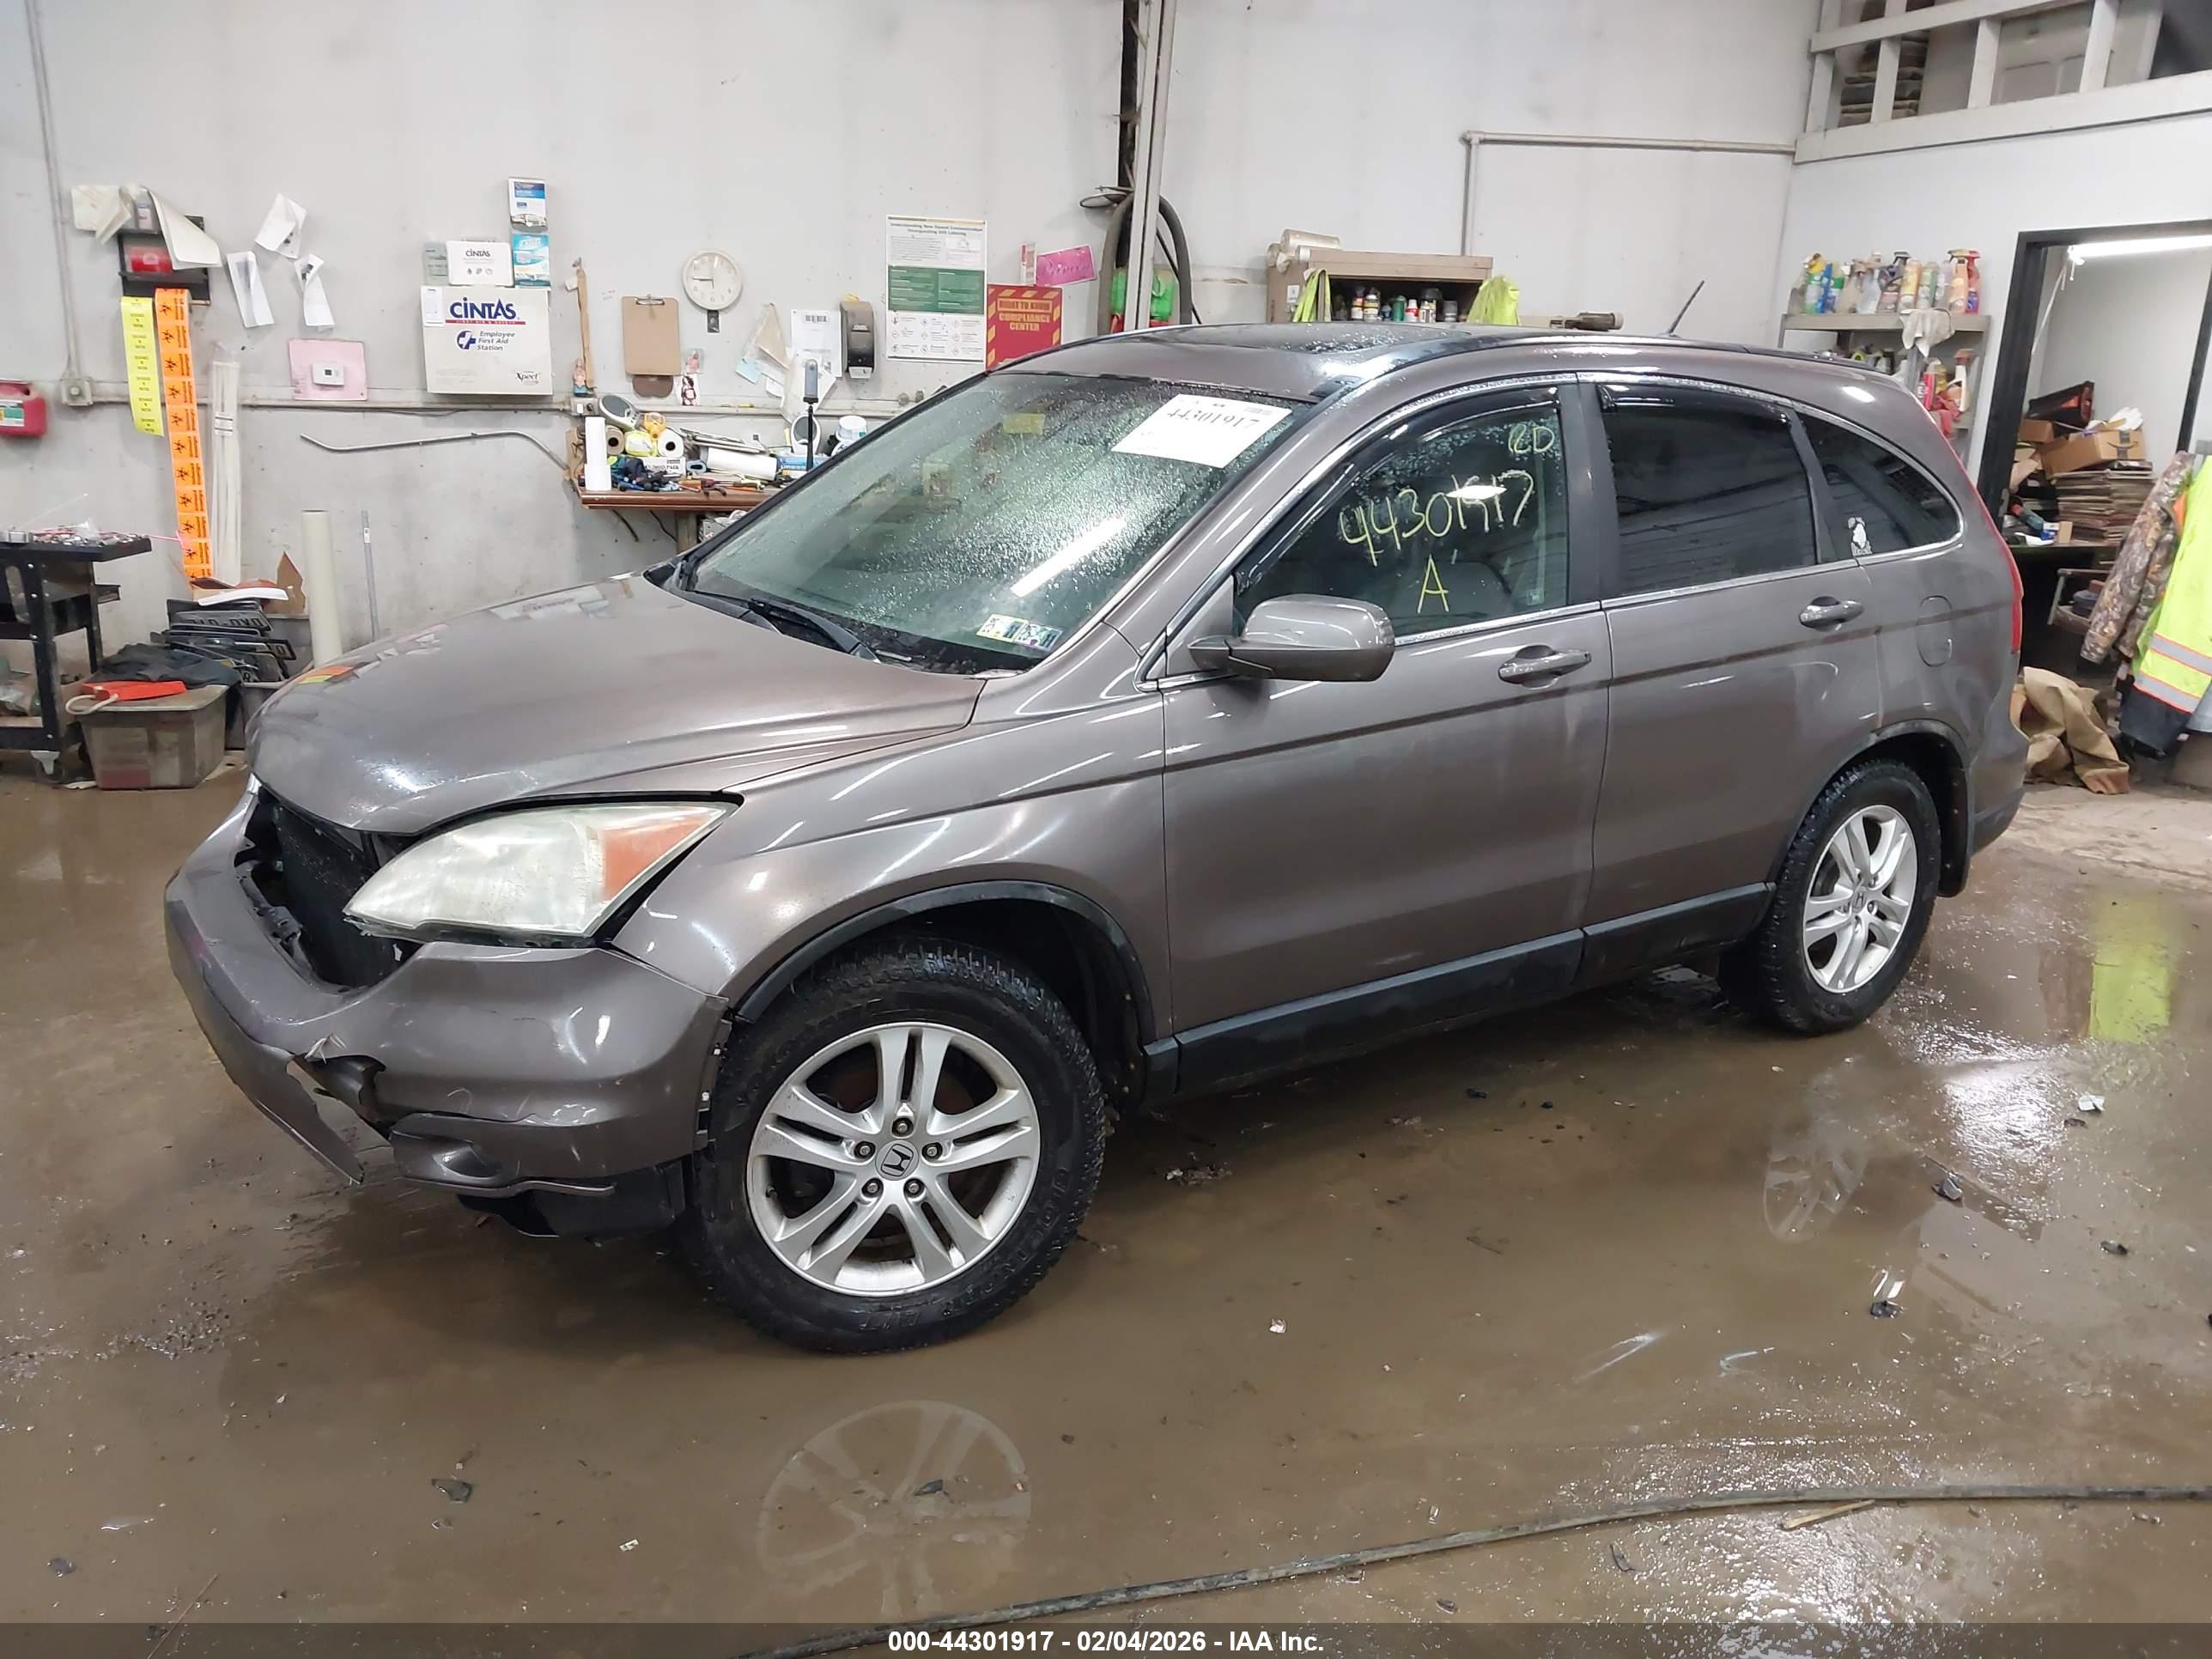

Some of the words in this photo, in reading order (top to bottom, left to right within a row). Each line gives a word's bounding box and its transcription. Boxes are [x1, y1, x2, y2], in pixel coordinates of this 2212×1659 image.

[465, 248, 491, 258] CINTAS
[449, 296, 517, 319] CINTAS
[999, 313, 1050, 323] COMPLIANCE
[1009, 322, 1040, 331] CENTER
[1417, 555, 1449, 614] A
